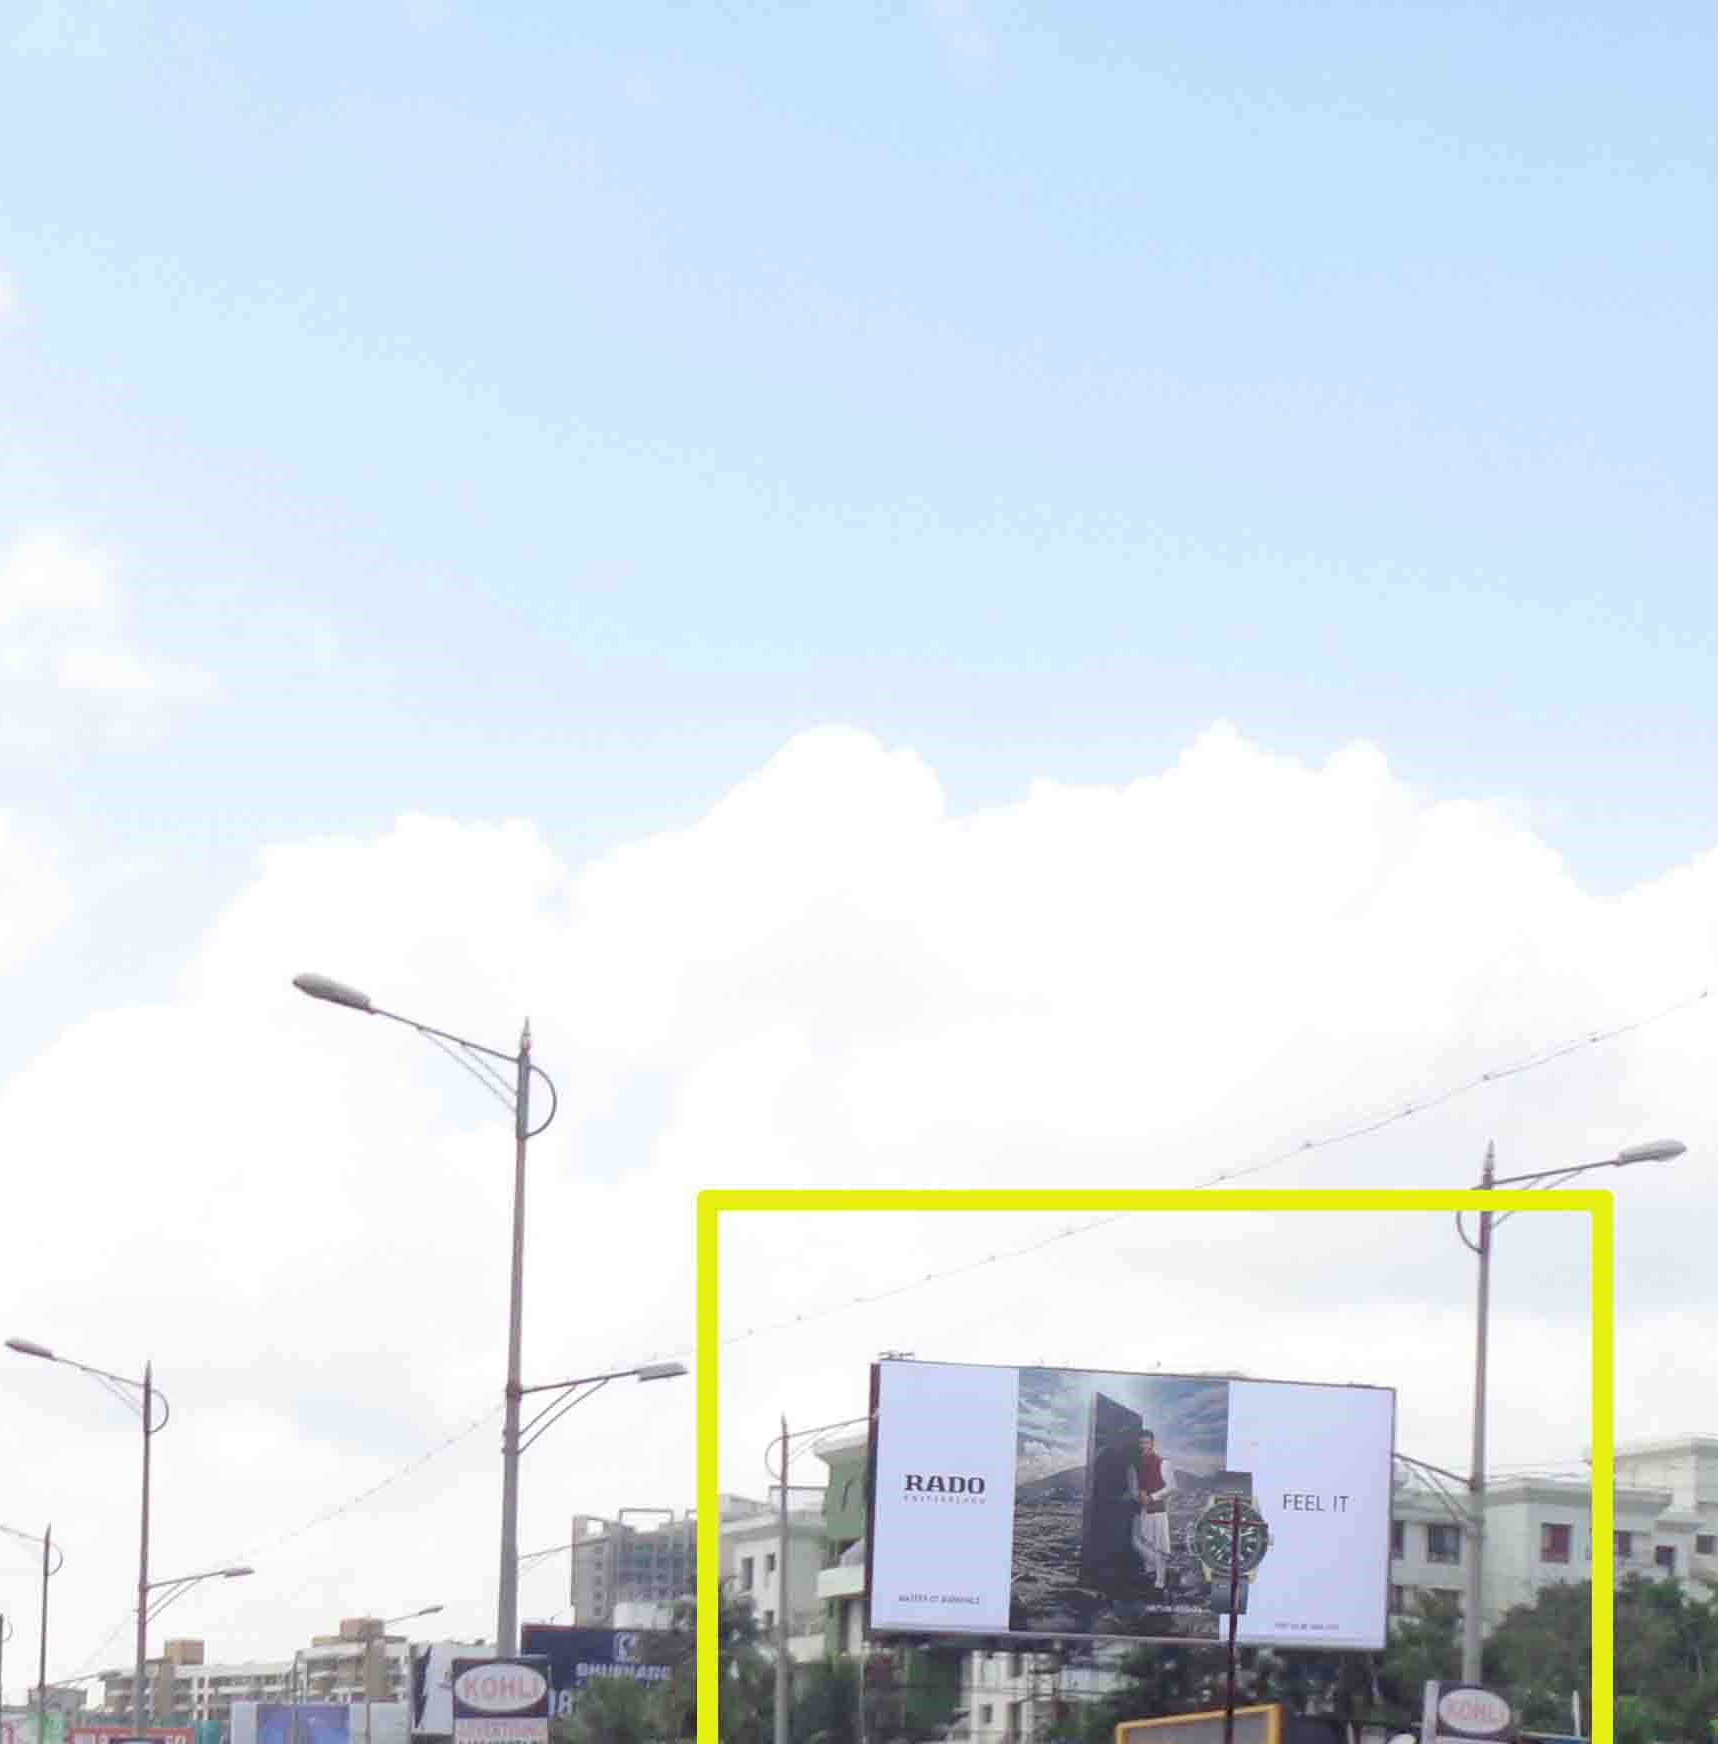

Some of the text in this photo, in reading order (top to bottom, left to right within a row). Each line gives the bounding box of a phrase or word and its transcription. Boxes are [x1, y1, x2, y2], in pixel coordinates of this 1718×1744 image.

[903, 1473, 985, 1494] RADO
[1283, 1493, 1350, 1513] FEEL IT
[463, 1679, 540, 1699] KOHLI
